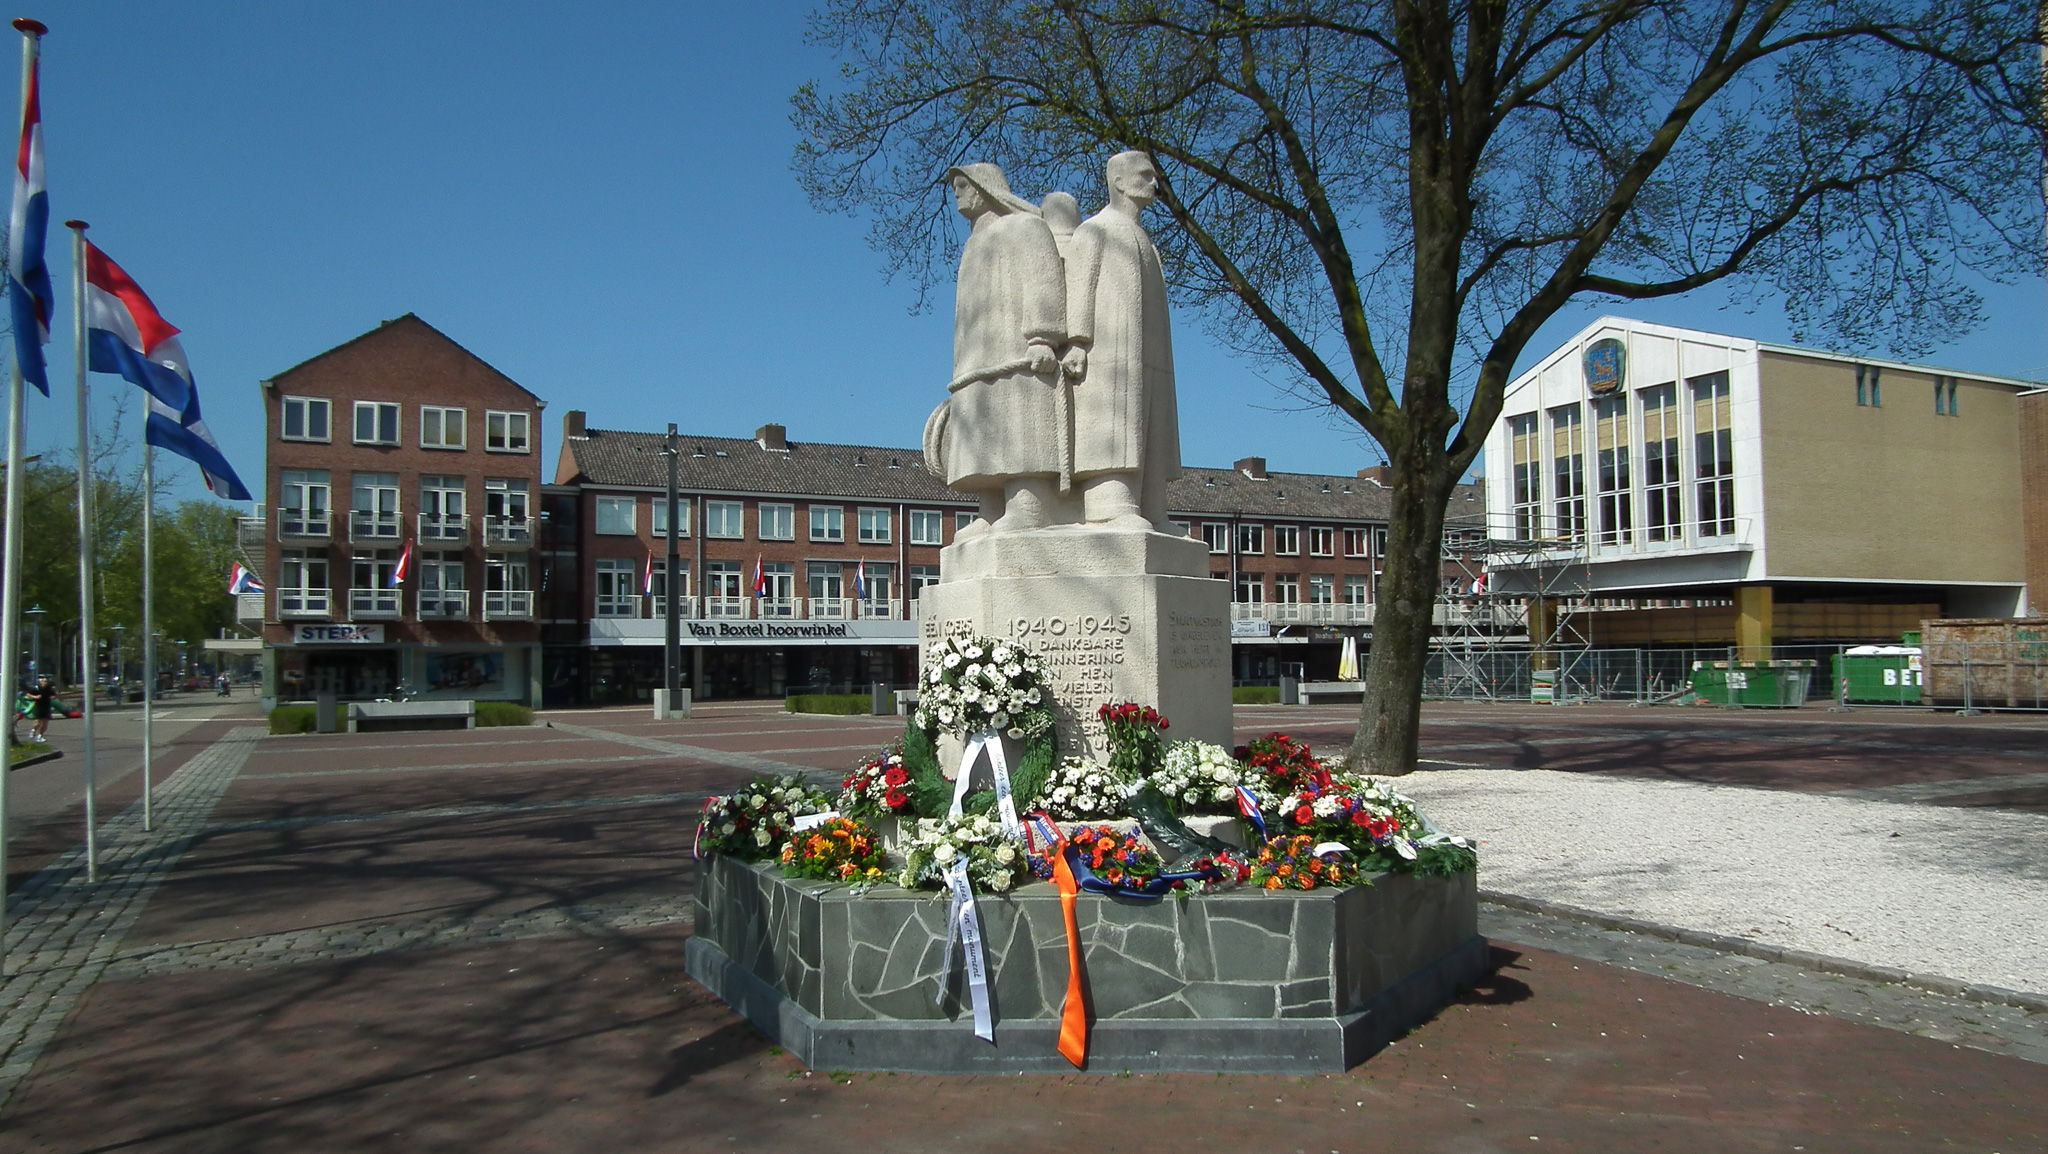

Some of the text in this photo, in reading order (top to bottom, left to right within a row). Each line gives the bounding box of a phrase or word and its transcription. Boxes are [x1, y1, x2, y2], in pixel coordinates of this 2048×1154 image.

[301, 626, 370, 641] STERK
[687, 622, 846, 637] Van Boxtel hoorwinkel
[1006, 614, 1132, 638] 1940-1945
[1039, 637, 1124, 652] DANKBARE
[1048, 652, 1125, 666] INNERING
[1080, 666, 1113, 680] HEN
[1061, 681, 1113, 695] VIELEN
[1052, 694, 1134, 710] ENST VA
[966, 929, 982, 979] monument
